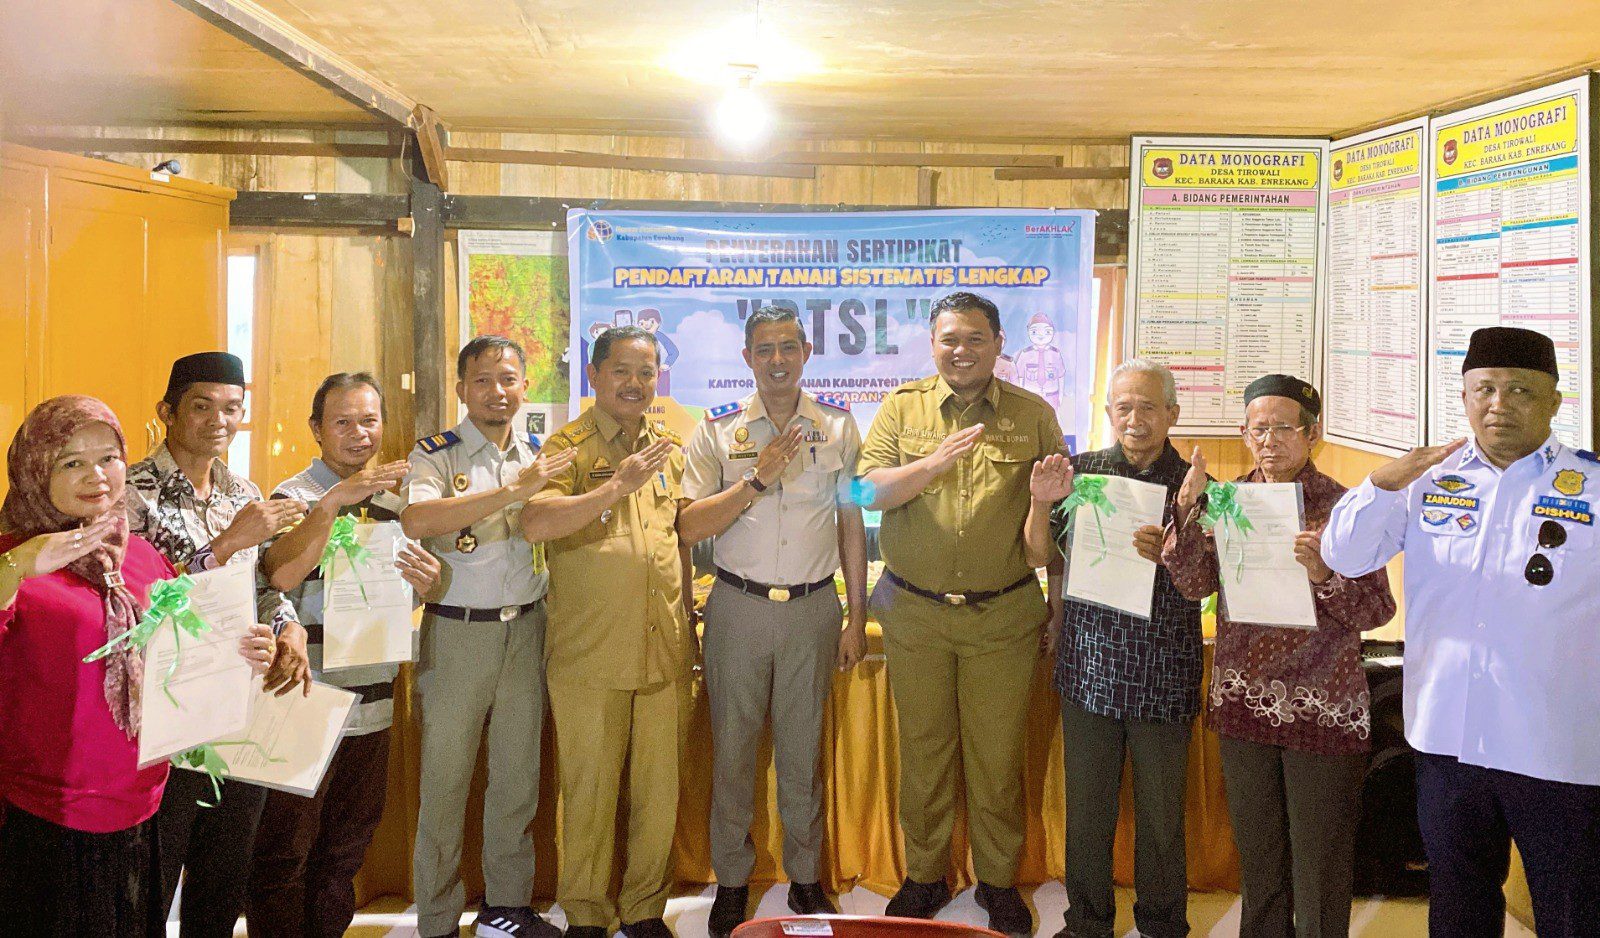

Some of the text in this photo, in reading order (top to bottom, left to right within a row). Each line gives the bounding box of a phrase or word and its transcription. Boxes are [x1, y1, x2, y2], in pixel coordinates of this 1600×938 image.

[1463, 106, 1568, 144] DATA MONOGRAFI
[1346, 136, 1414, 164] DATA MONOGRAFI
[1480, 153, 1506, 166] BARAKA
[1526, 140, 1567, 156] ENREKANG
[1484, 134, 1536, 153] DESA TIROWALI
[1179, 153, 1305, 167] DATA MONOGRAFI
[1174, 177, 1196, 185] KEC.
[1198, 177, 1235, 185] BARAKA
[1260, 178, 1309, 186] ENREKANG
[1210, 168, 1281, 177] DESA TIROWALI
[1467, 173, 1492, 185] BIDANG
[1494, 164, 1549, 181] PEMBANGUNAN
[1171, 193, 1290, 204] A. BIDANG PEMERINTAHAN
[1025, 223, 1074, 233] BerAKHLAK
[705, 238, 963, 263] PENYERAHAN SERTIPIKAT
[614, 267, 1050, 286] PENDAFTARAN TANAH SISTEMATIS LENGKAP
[1425, 494, 1477, 508] ZAINUDDIN
